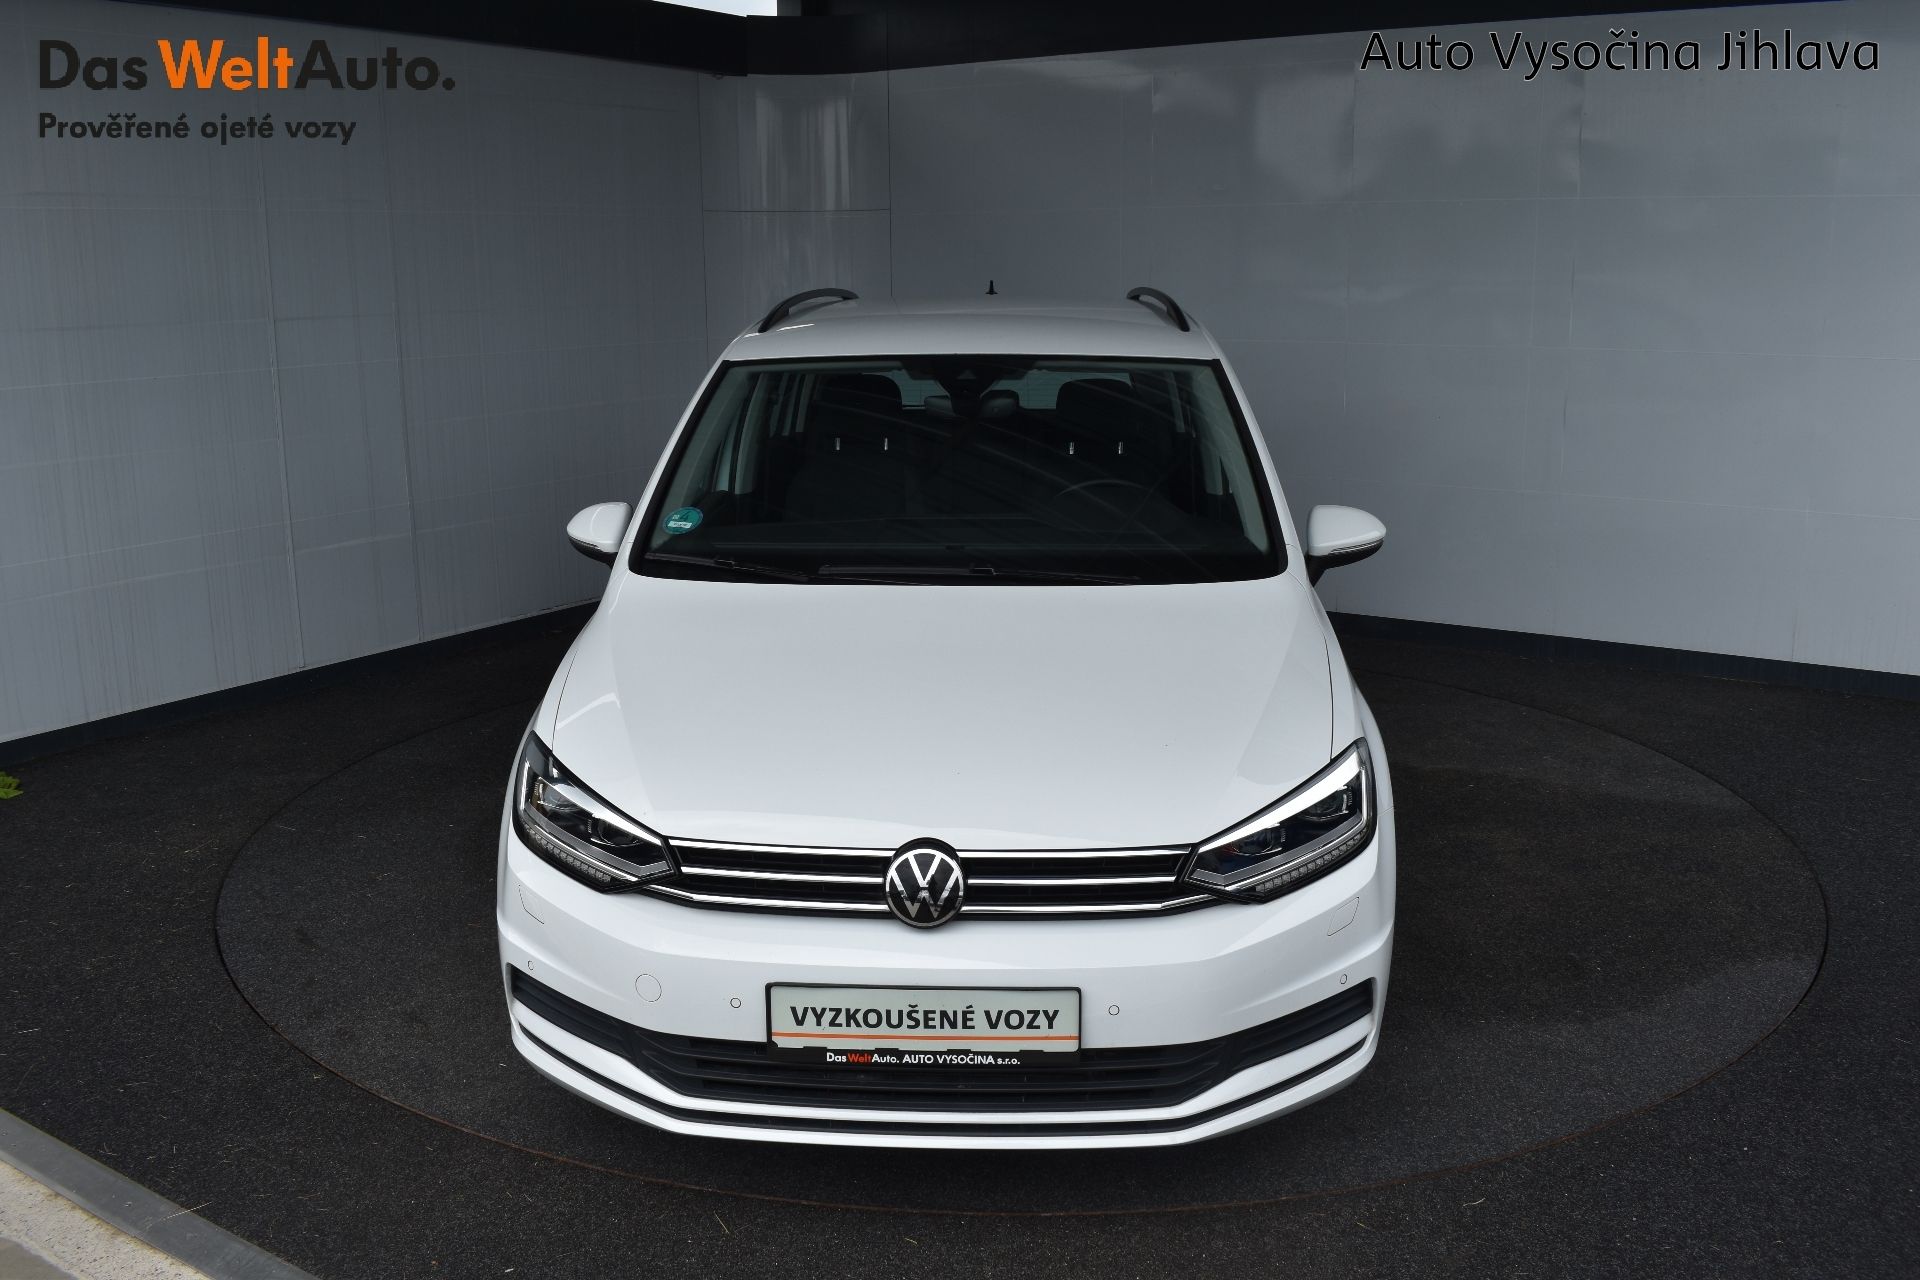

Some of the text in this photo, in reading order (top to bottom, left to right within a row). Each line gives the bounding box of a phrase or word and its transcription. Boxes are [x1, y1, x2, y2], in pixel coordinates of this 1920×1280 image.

[790, 1004, 1059, 1030] VYZKOUŠENÉ VOZY
[902, 1054, 934, 1064] AUTO
[936, 1053, 995, 1065] VYSOČINA
